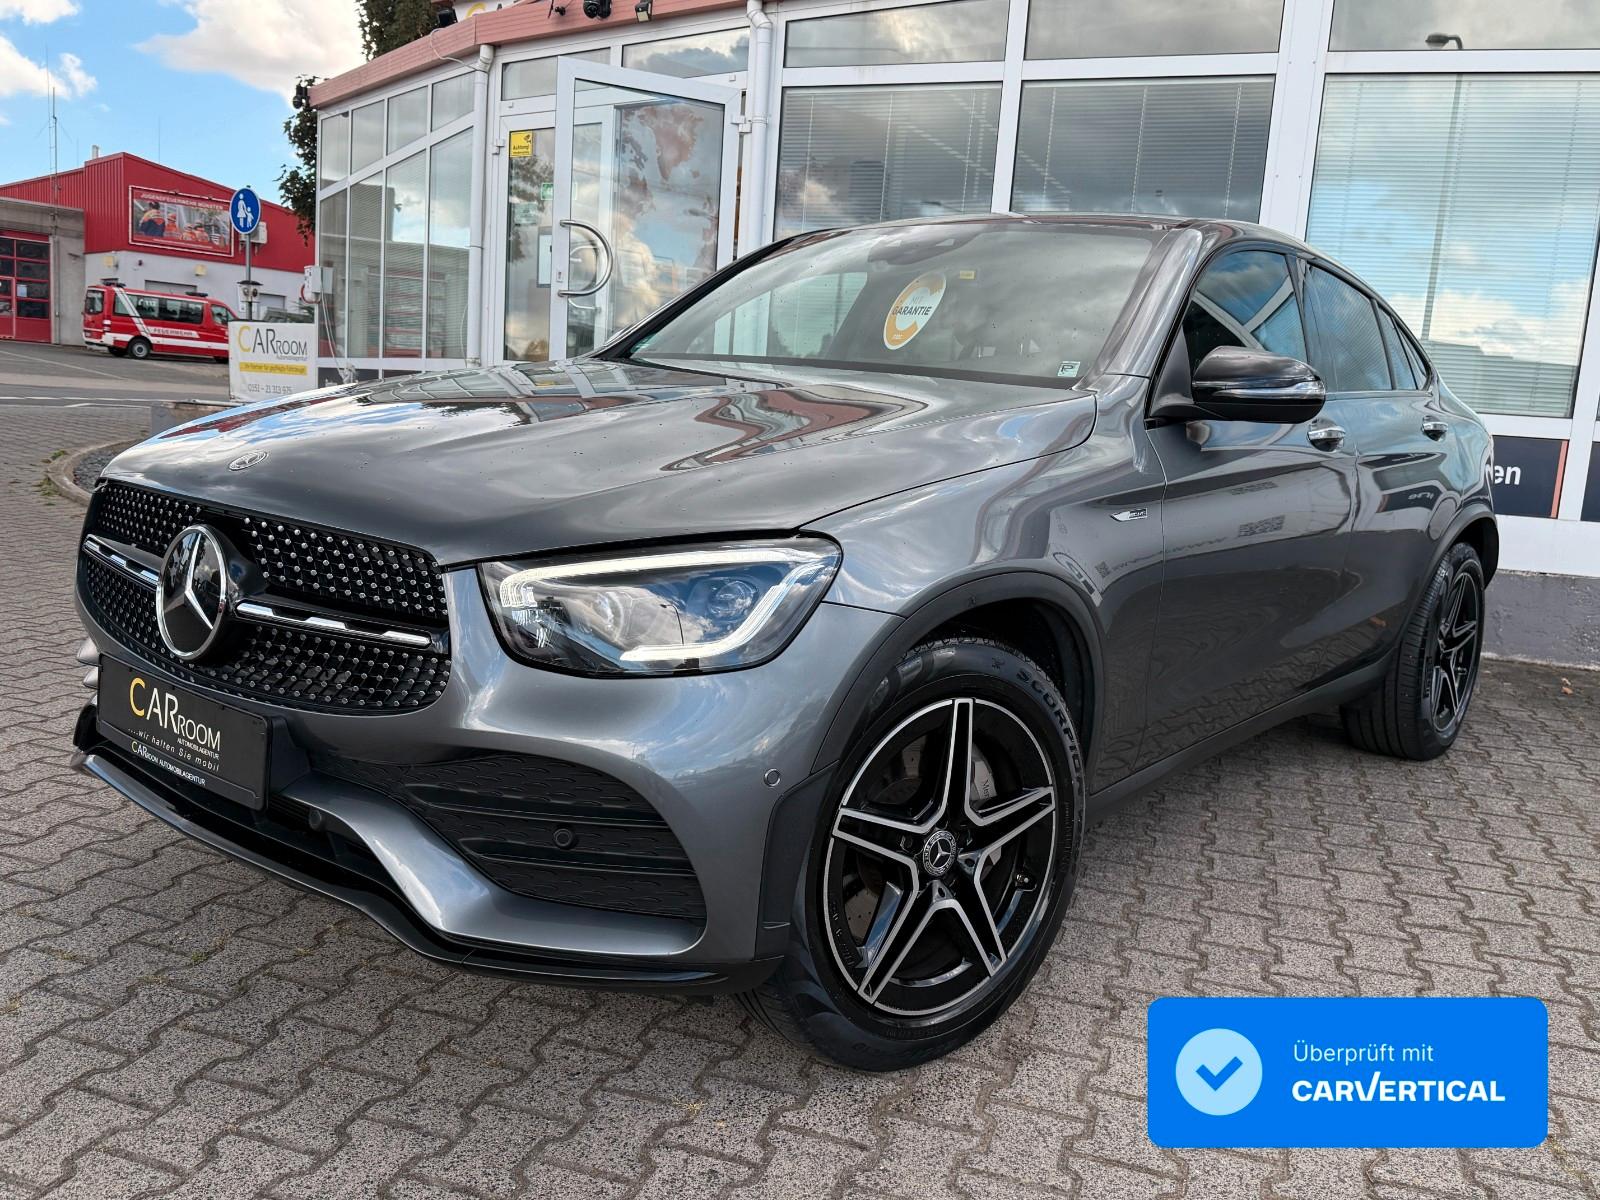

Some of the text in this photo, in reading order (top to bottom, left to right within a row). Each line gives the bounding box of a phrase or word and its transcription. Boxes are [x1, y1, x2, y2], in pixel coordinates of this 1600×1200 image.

[892, 305, 933, 316] GARANTIE
[153, 326, 194, 337] FEUERWEHR
[129, 677, 221, 752] CARROOM
[151, 735, 176, 753] halten
[178, 748, 192, 760] Sie
[194, 757, 220, 772] mobil
[177, 737, 220, 760] AUTOMOBILAGENTUR
[158, 759, 206, 787] AUTOMOBILAGENTUR
